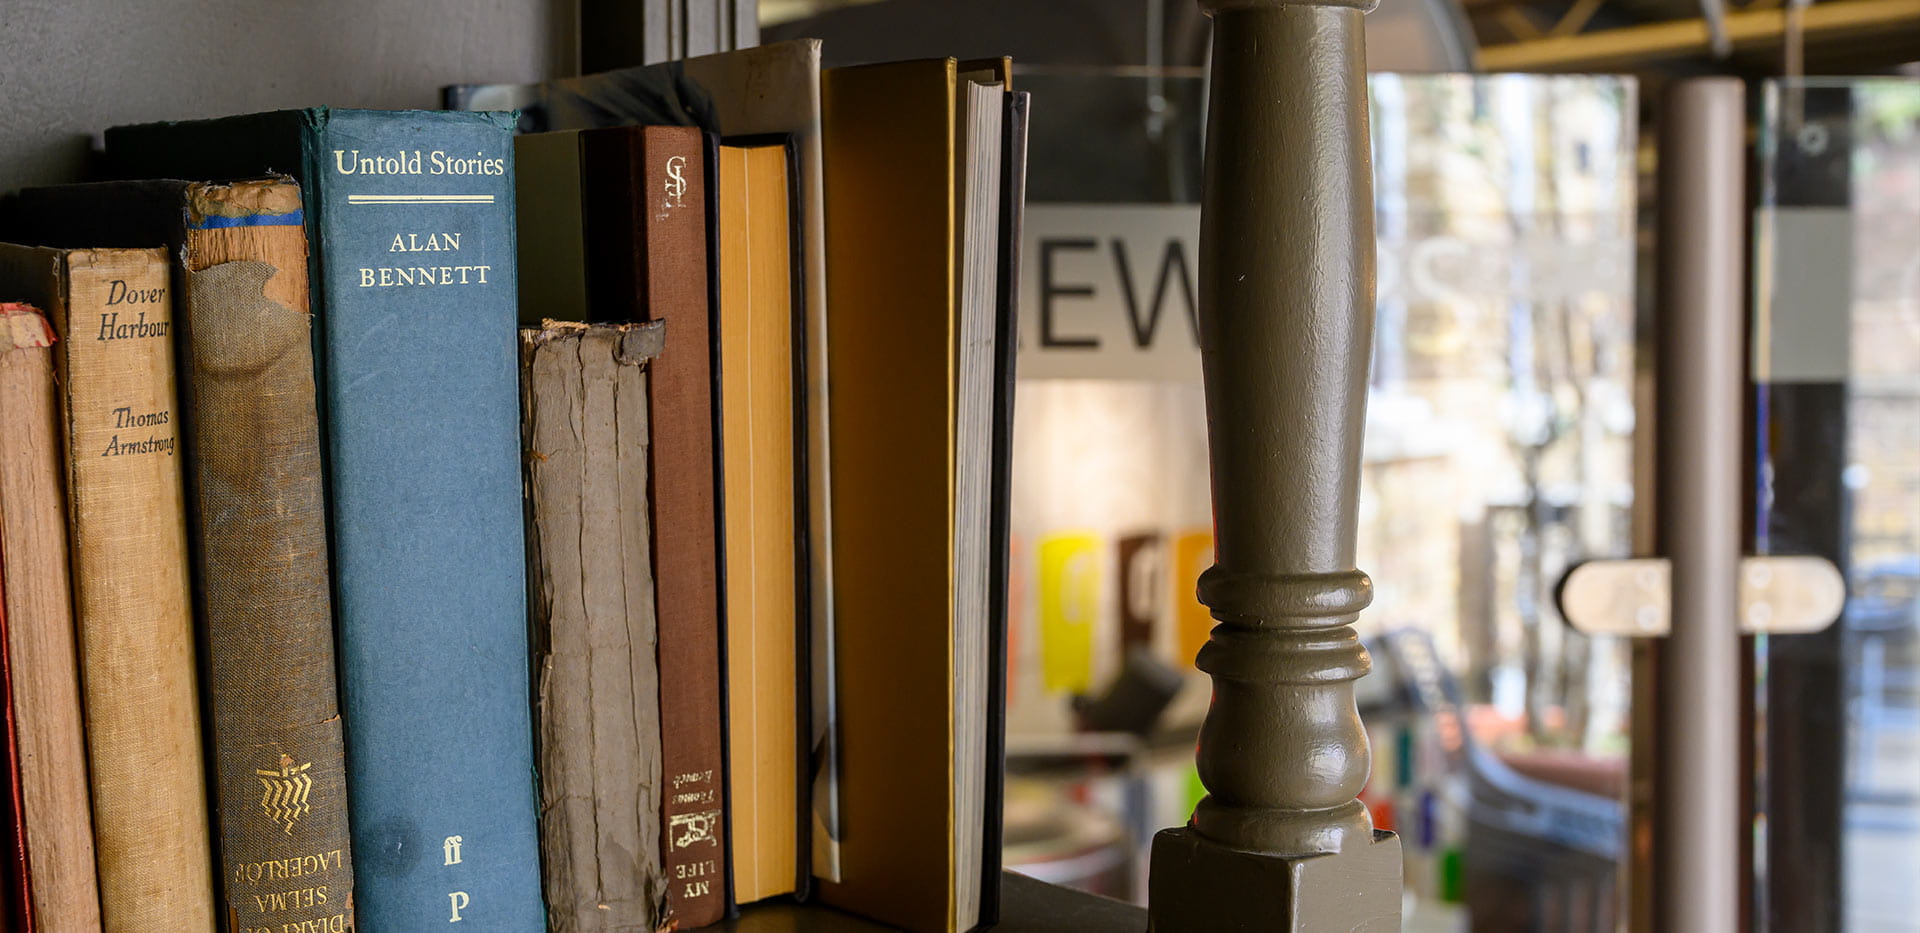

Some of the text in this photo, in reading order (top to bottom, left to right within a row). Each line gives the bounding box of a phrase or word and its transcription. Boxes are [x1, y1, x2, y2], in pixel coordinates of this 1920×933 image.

[334, 150, 504, 175] Untold Stories
[389, 233, 461, 252] ALAN
[359, 265, 491, 287] BENNETT
[106, 279, 165, 306] Dover
[1019, 237, 1201, 350] EW
[97, 311, 170, 341] Harbour
[112, 406, 169, 429] Thomas
[101, 434, 175, 457] Armstrong
[442, 835, 463, 866] ff
[675, 860, 716, 879] LIFE
[254, 885, 327, 913] SELMA
[684, 880, 710, 898] MY
[448, 891, 470, 923] P
